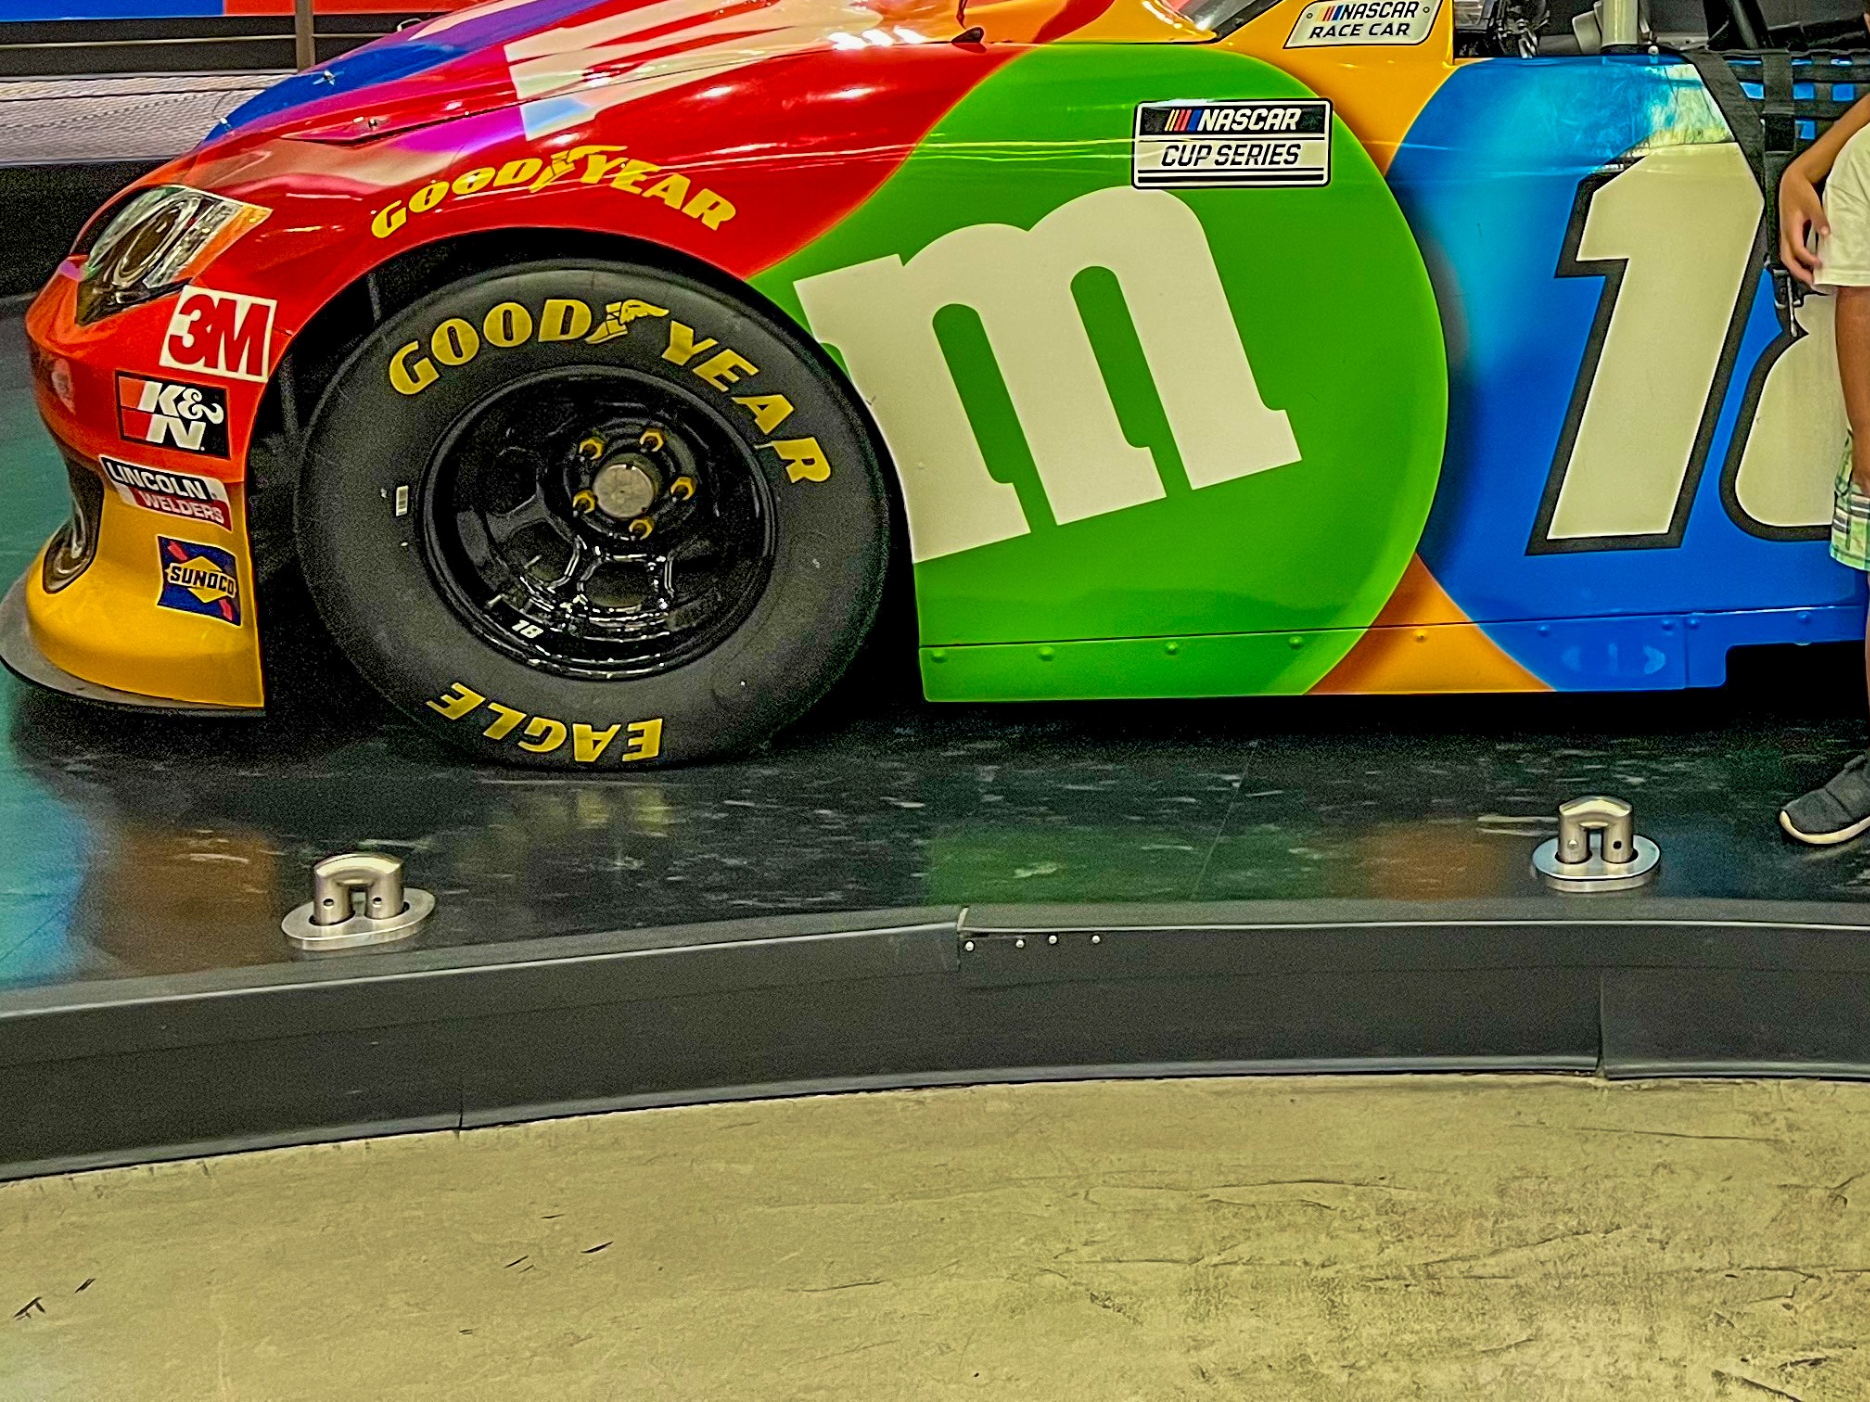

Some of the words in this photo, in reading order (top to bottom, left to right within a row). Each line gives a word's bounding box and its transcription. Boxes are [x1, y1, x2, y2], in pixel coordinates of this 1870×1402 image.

[1341, 1, 1419, 20] NASCAR
[1309, 24, 1361, 39] RACE
[1368, 23, 1410, 36] CAR
[1198, 108, 1302, 131] NASCAR
[1161, 144, 1212, 167] CUP
[1214, 143, 1302, 166] SERIES
[168, 294, 271, 376] 3M
[106, 461, 208, 500] LINCOLN
[139, 490, 225, 524] WELDERS
[170, 564, 235, 597] SUNOCO
[512, 620, 544, 638] 18
[425, 681, 665, 764] EAGLE
